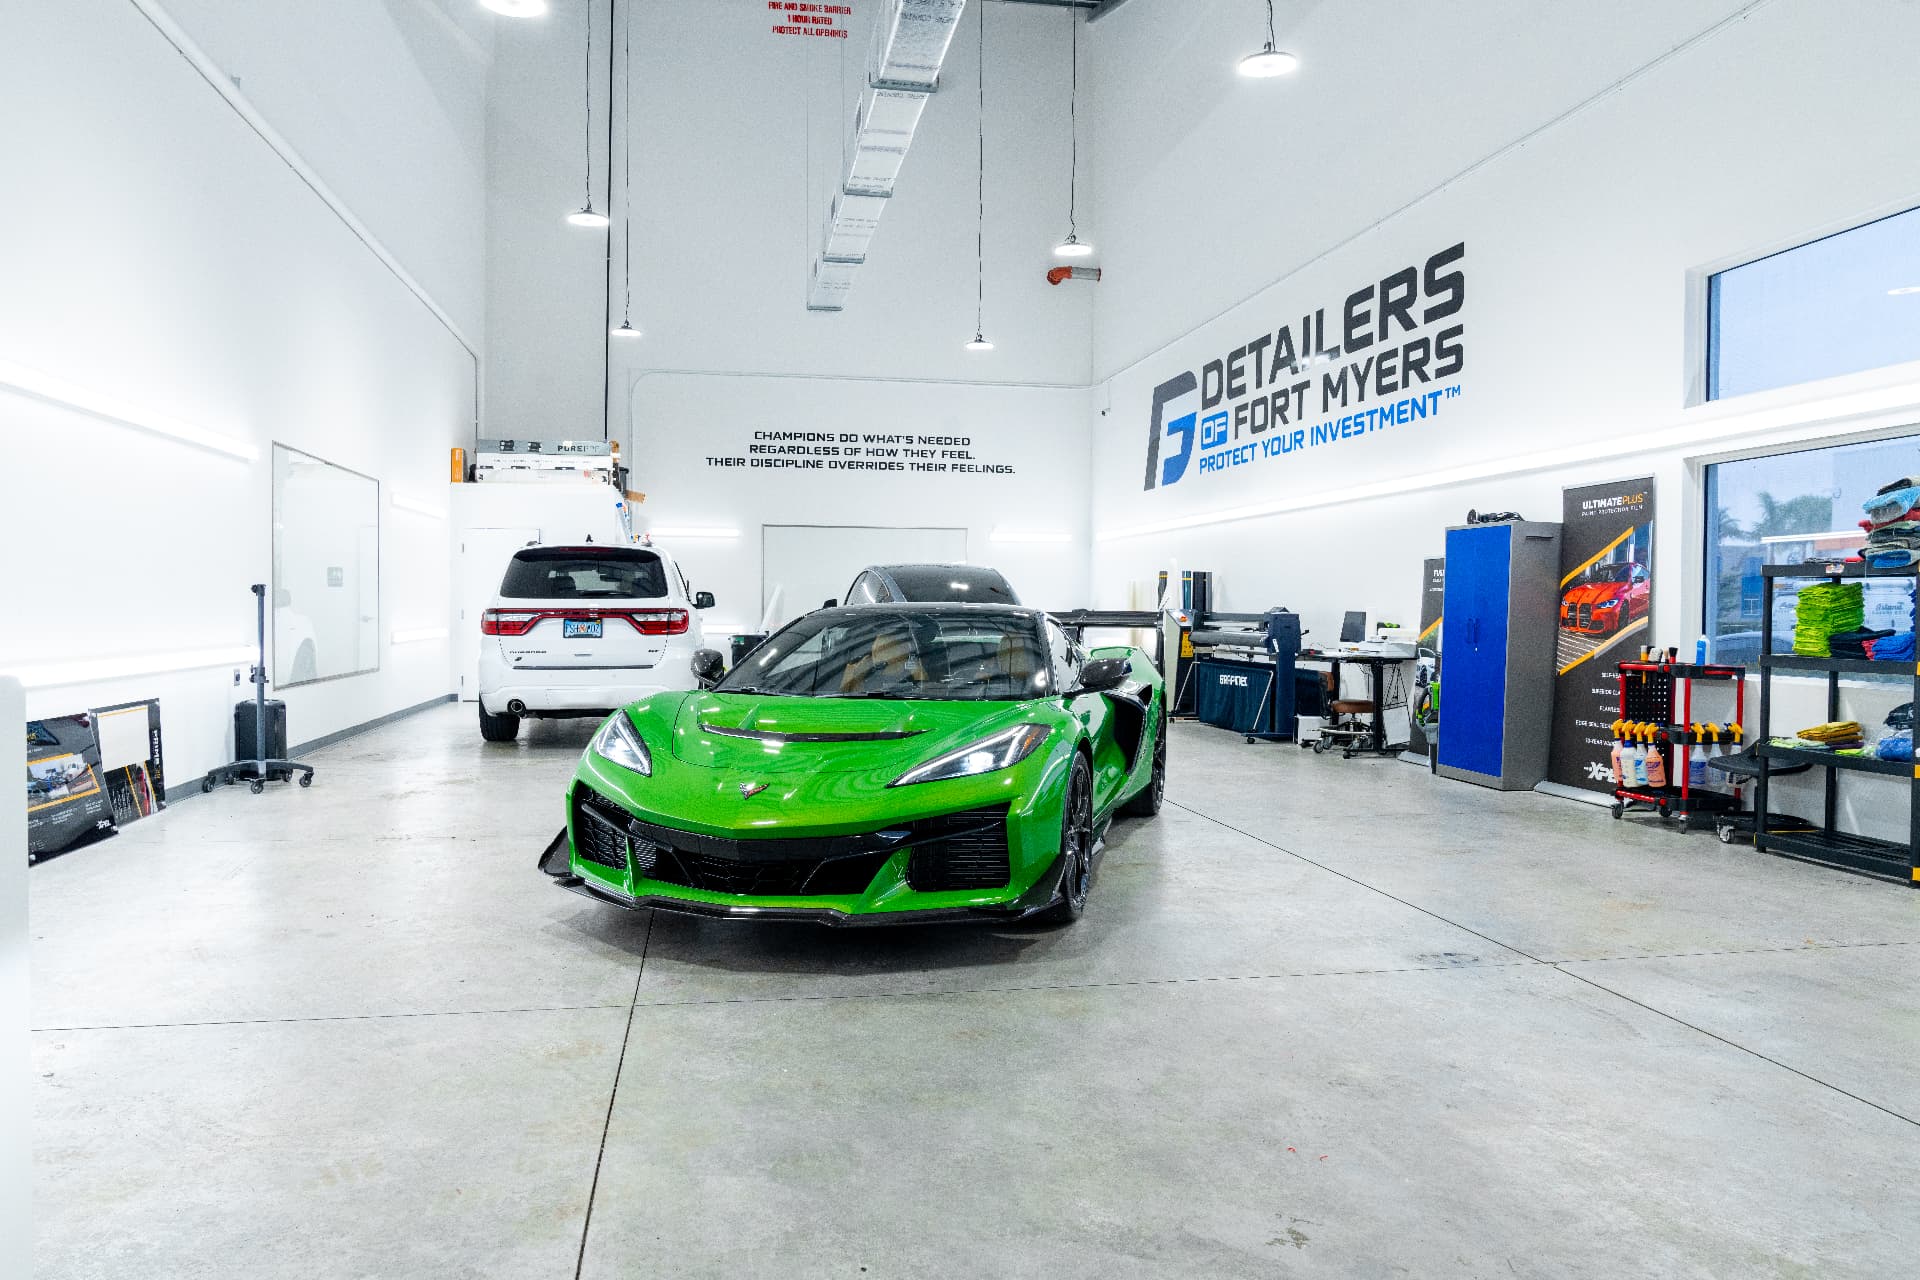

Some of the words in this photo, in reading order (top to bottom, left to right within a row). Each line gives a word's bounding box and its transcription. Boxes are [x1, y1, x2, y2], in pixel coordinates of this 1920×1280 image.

[768, 1, 782, 10] FIRE
[784, 2, 798, 11] AND
[799, 3, 823, 13] SMOKE
[823, 5, 852, 15] BARRIER
[792, 14, 811, 24] HOUR
[811, 17, 833, 25] RATED
[772, 25, 801, 35] PROTECT
[802, 27, 815, 36] ALL
[815, 28, 848, 39] OPENINGS
[1201, 241, 1465, 411] DETAILERS
[1202, 413, 1227, 446] OF
[1235, 379, 1311, 440] FORT
[1322, 323, 1464, 413] MYERS
[754, 431, 835, 442] CHAMPIONS
[839, 433, 858, 443] DO
[862, 434, 914, 444] WHAT'S
[918, 436, 971, 446] NEEDED
[749, 444, 840, 456] REGARDLESS
[844, 447, 862, 456] OF
[866, 447, 898, 457] HOW
[902, 448, 936, 459] THEY
[941, 450, 976, 460] FEEL.
[1199, 443, 1257, 475] PROTECT
[1262, 430, 1305, 458] YOUR
[705, 457, 746, 467] THEIR
[750, 458, 824, 469] DISCIPLINE
[828, 460, 905, 471] OVERRIDES
[909, 462, 947, 472] THEIR
[951, 463, 1016, 474] FEELINGS.
[1585, 761, 1617, 783] XPE
